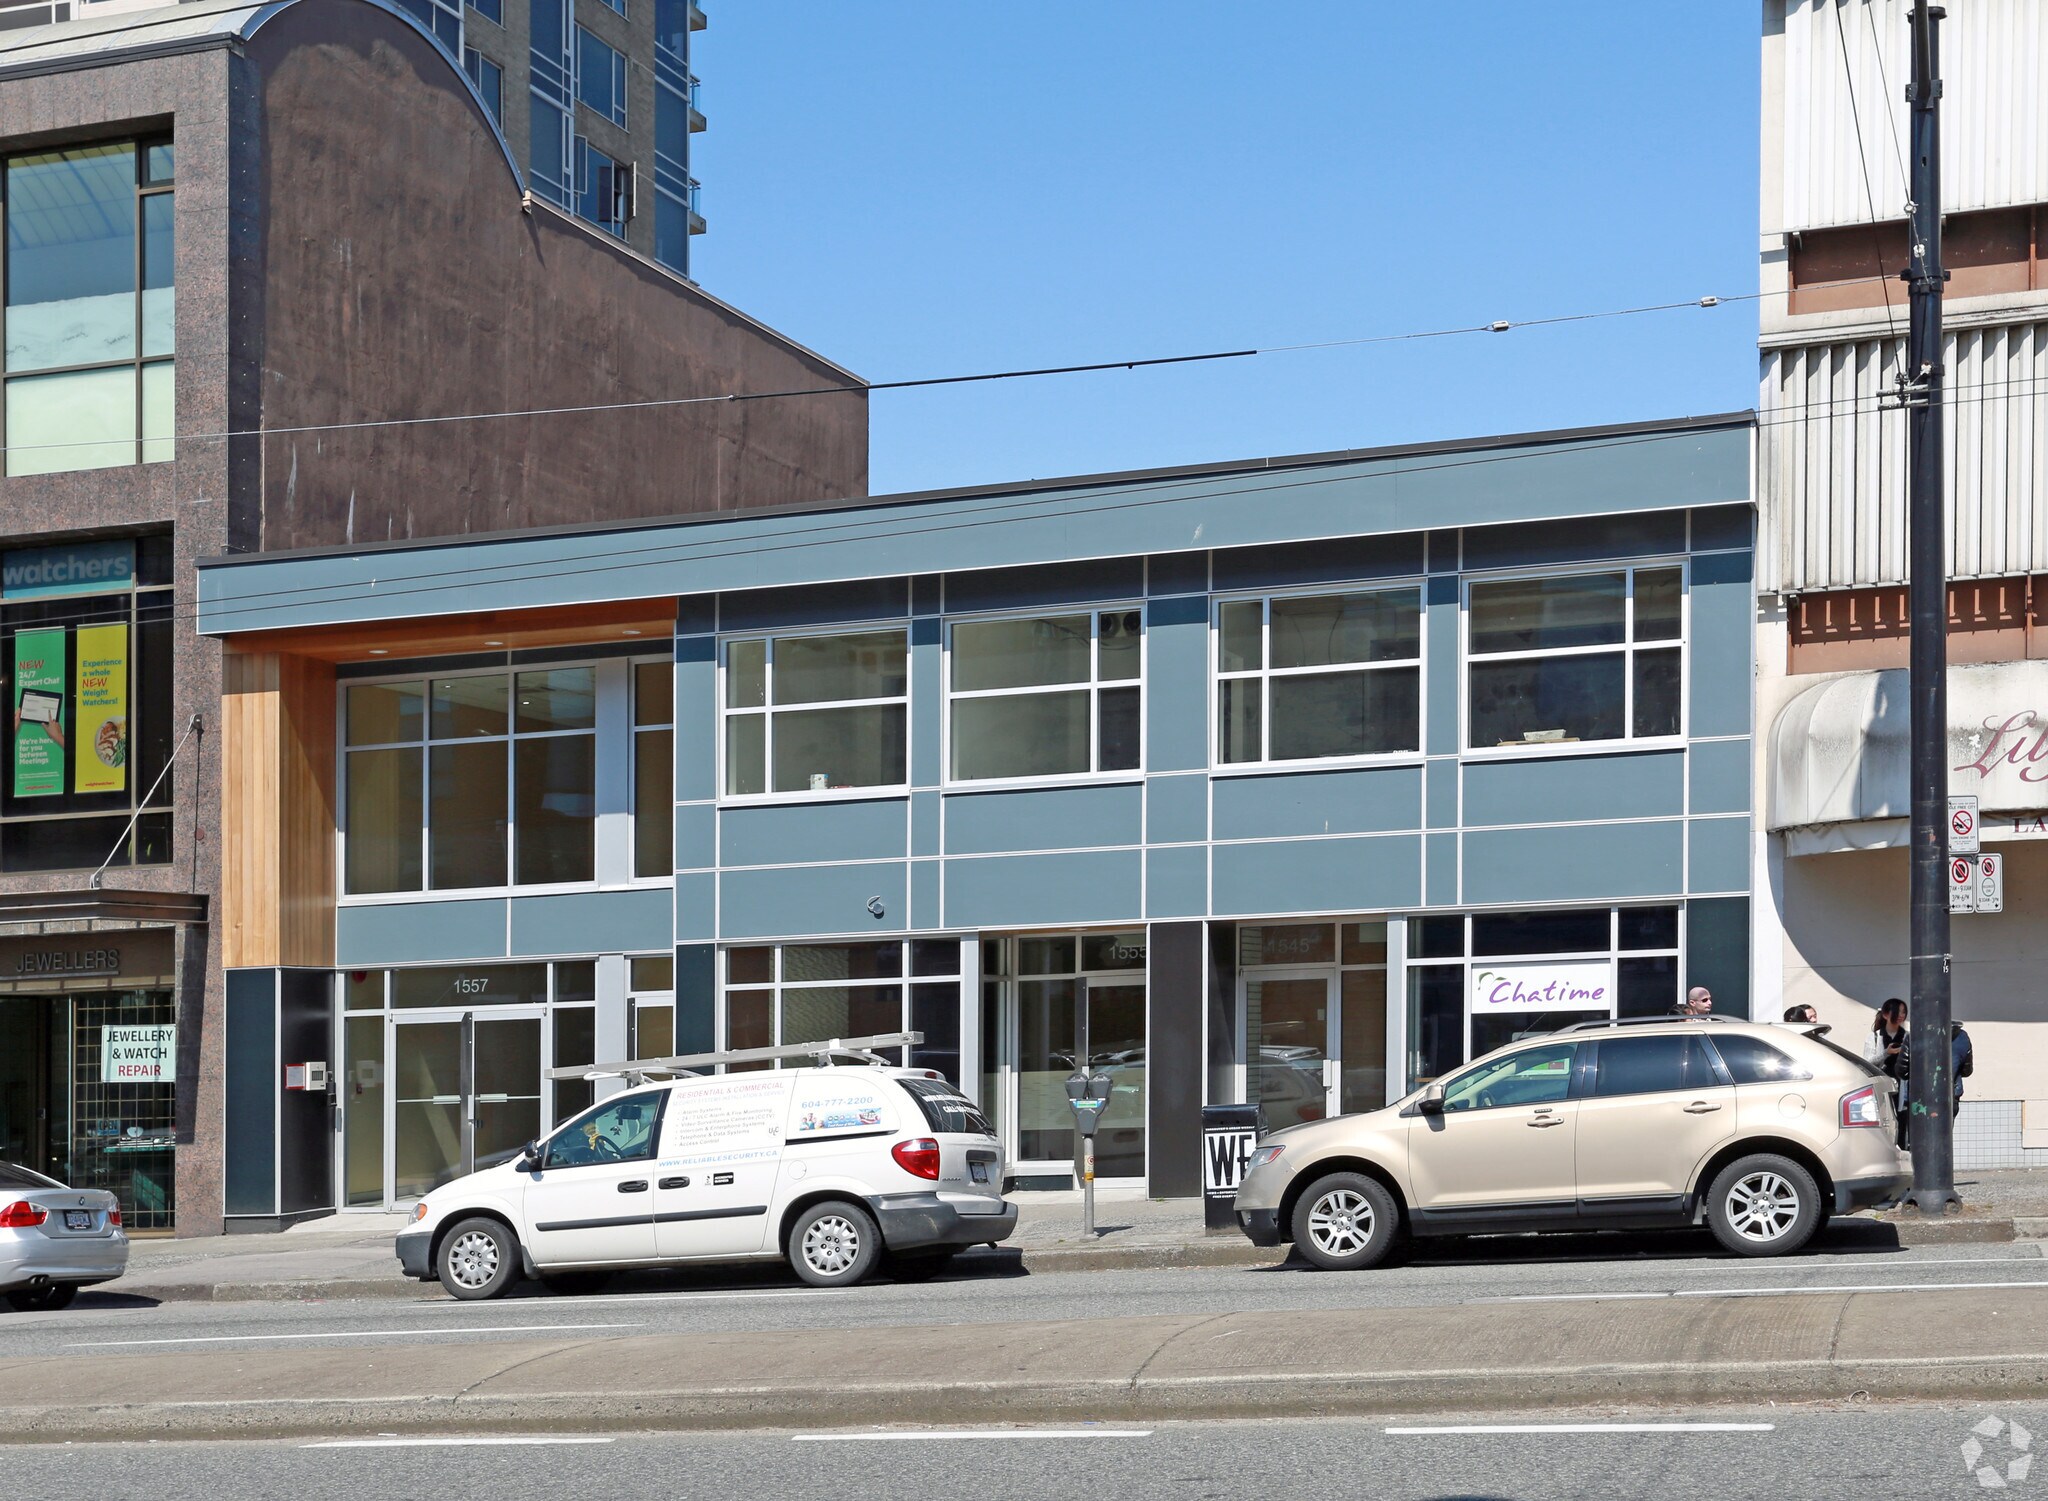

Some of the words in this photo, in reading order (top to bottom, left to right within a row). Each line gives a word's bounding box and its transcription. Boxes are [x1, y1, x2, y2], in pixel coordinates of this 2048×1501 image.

[3, 554, 128, 585] watchers
[19, 659, 44, 670] NEW
[82, 659, 122, 669] Experience
[19, 671, 36, 679] 24/7
[19, 679, 43, 688] Expert
[44, 677, 60, 685] Chat
[82, 678, 107, 688] NEW
[82, 689, 108, 699] Weight
[82, 698, 118, 707] Watchers!
[1953, 709, 2048, 782] Lil
[19, 758, 49, 766] Meetings
[1267, 937, 1310, 954] 1545
[1110, 944, 1146, 960] 1555
[16, 949, 120, 973] JEWELLERS
[454, 978, 489, 993] 1557
[1489, 980, 1605, 1003] Chatime
[107, 1030, 173, 1042] JEWELLERY
[112, 1048, 121, 1059] &
[124, 1048, 167, 1059] WATCH
[118, 1065, 161, 1076] REPAIR
[676, 1087, 725, 1100] RESIDENTIAL
[733, 1082, 784, 1093] COMMERCIAL
[801, 1096, 873, 1109] 604-777-2200
[679, 1133, 707, 1142] Telephone
[699, 1138, 720, 1146] Control
[658, 1150, 778, 1167] WWW.RELIABLESECURITY.CA
